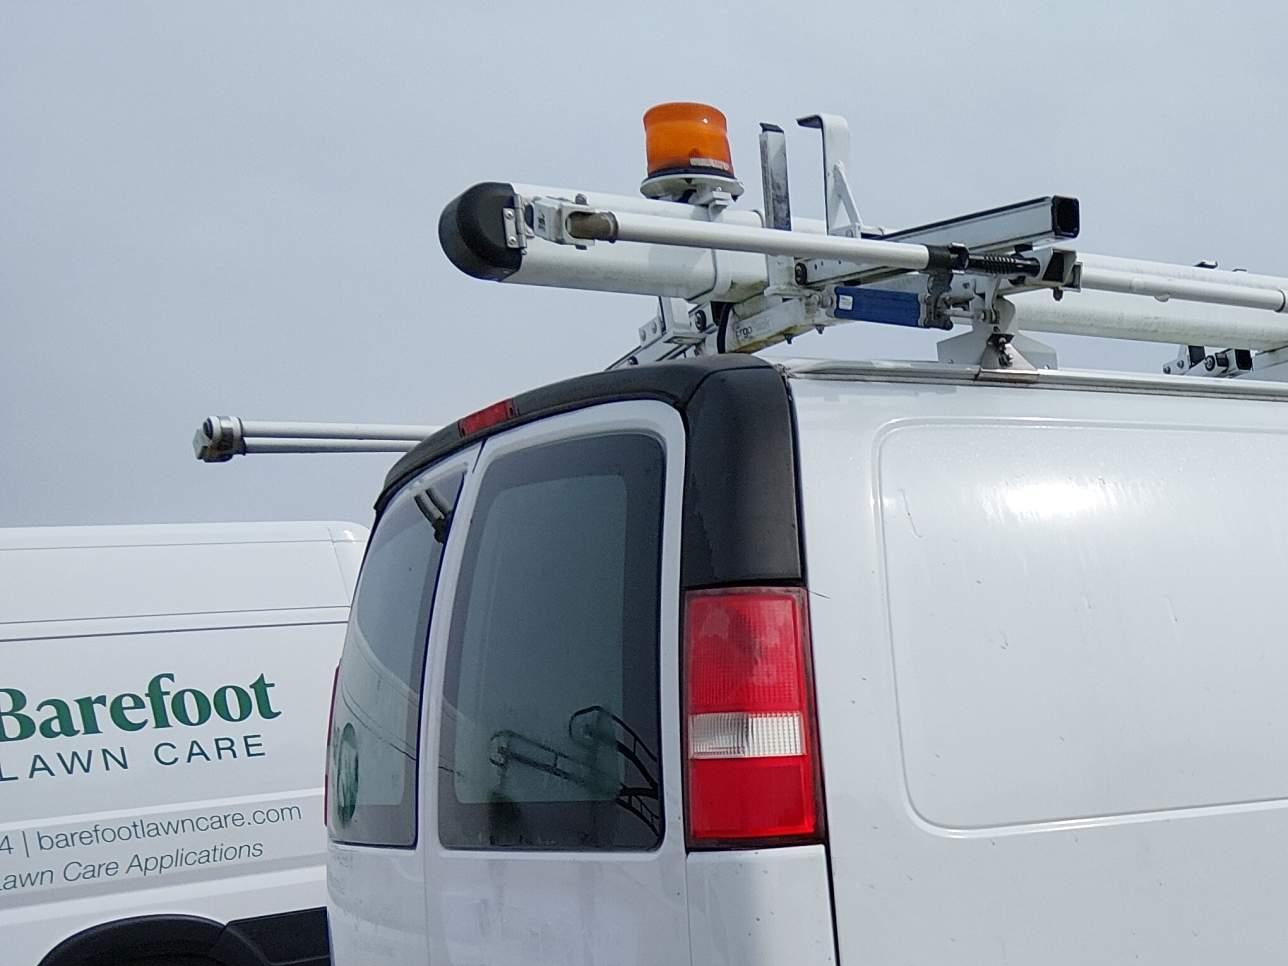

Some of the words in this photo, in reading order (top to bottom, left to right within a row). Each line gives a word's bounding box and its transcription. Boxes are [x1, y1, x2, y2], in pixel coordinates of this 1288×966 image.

[0, 672, 282, 742] Barefoot
[153, 734, 266, 766] CARE
[37, 804, 302, 851] barefootlawncare.com
[0, 869, 54, 891] awn
[63, 856, 119, 882] Care
[125, 841, 264, 877] Applications
